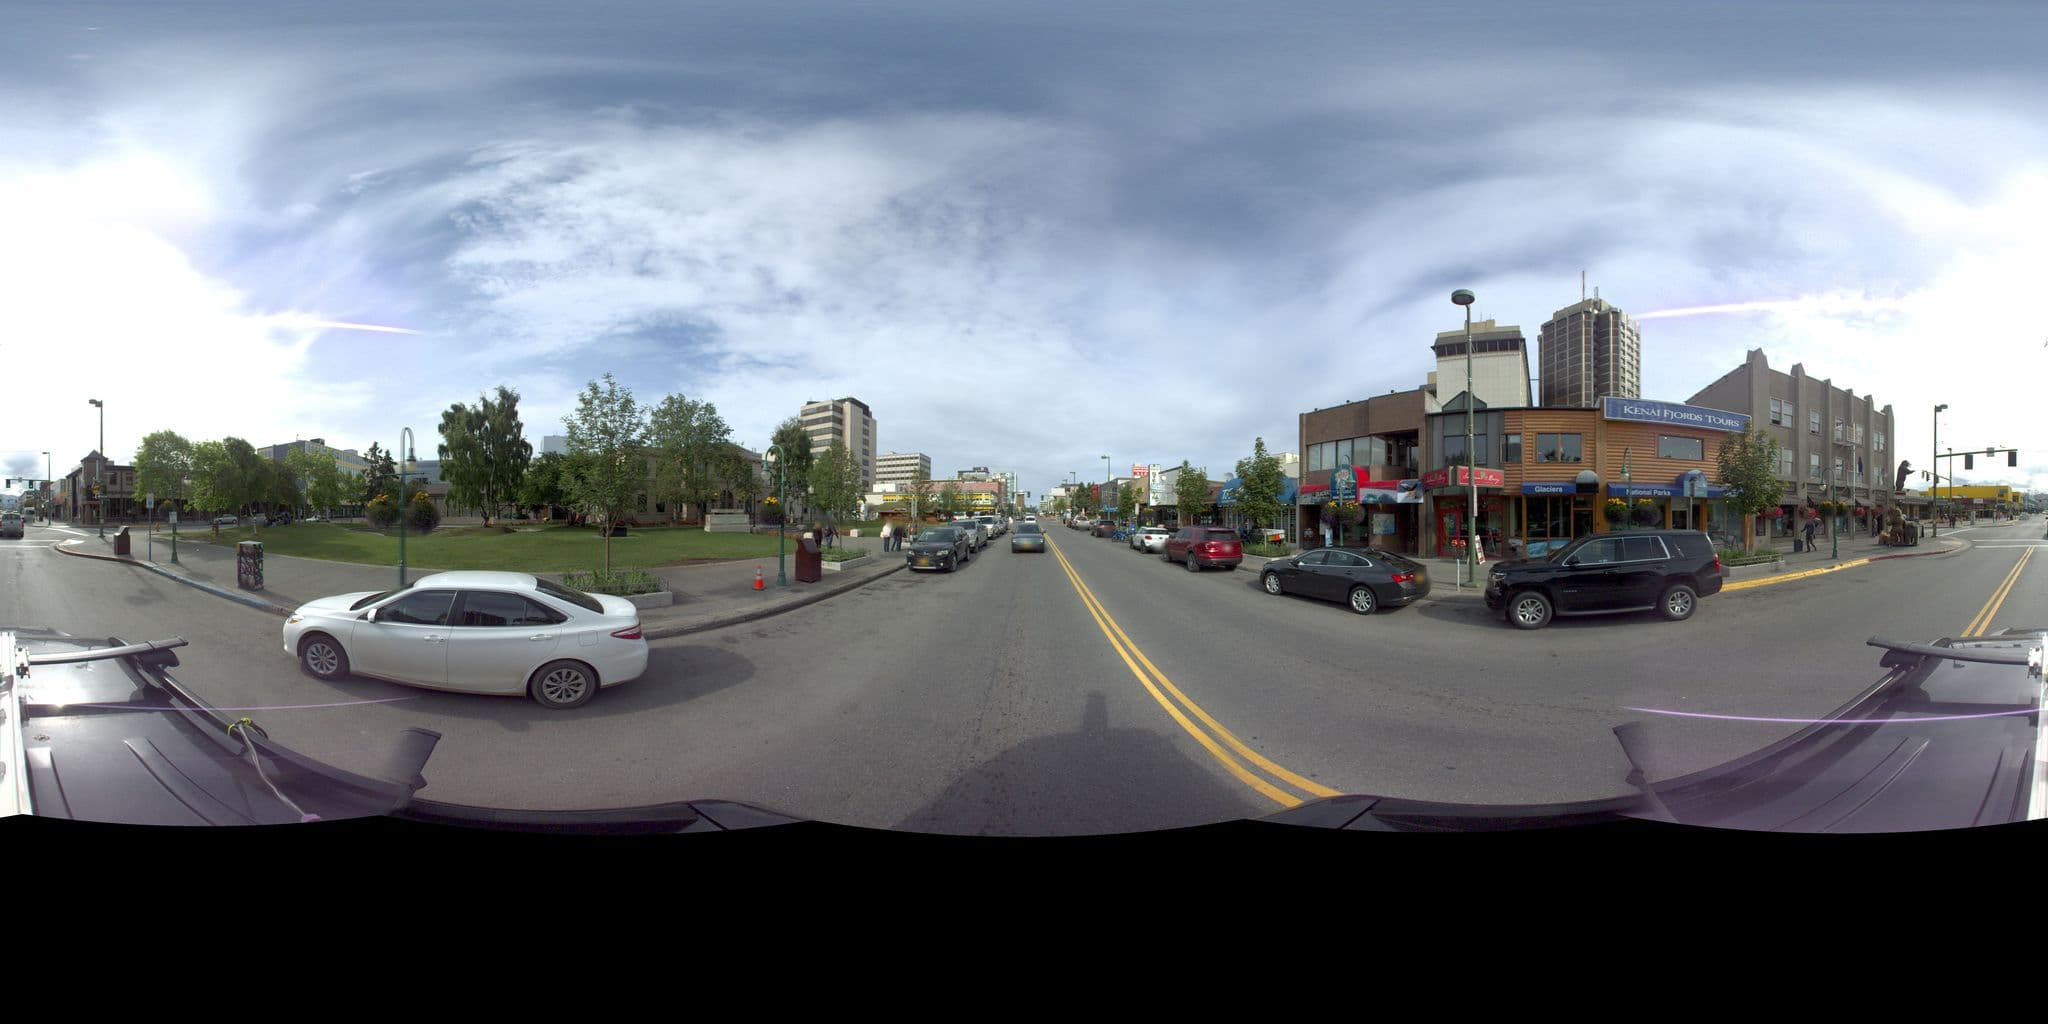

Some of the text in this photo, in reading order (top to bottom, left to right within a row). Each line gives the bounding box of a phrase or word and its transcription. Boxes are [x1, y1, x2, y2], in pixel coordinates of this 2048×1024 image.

[1623, 405, 1740, 427] KENAI FJORDS TOURS
[1534, 485, 1563, 493] Glaciers
[1653, 489, 1672, 497] Parks
